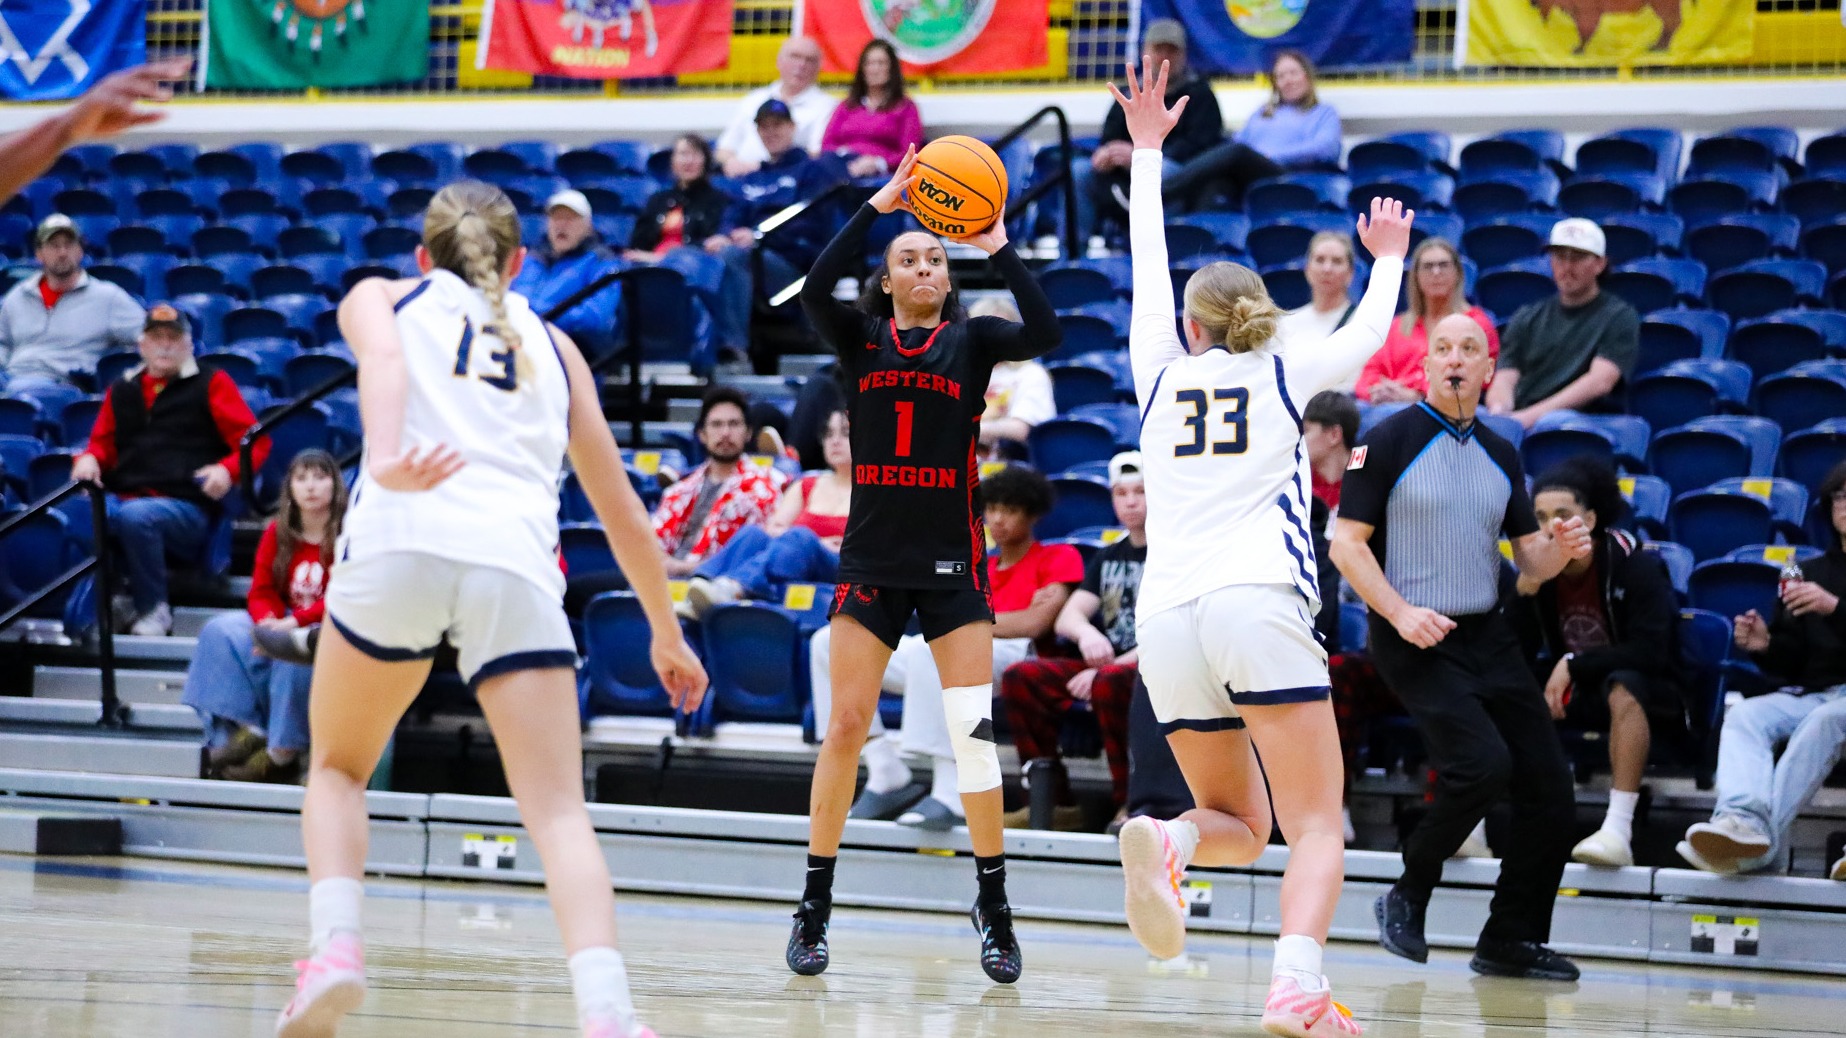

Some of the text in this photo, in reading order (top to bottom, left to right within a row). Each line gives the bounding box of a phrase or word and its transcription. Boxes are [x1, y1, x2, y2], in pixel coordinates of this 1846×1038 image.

[552, 45, 630, 68] NATION
[918, 177, 966, 212] NCAA
[452, 314, 519, 394] 13
[859, 370, 961, 400] WESTERN
[895, 401, 914, 457] 1
[1174, 386, 1250, 459] 33
[856, 464, 957, 488] OREGON
[956, 564, 962, 572] S
